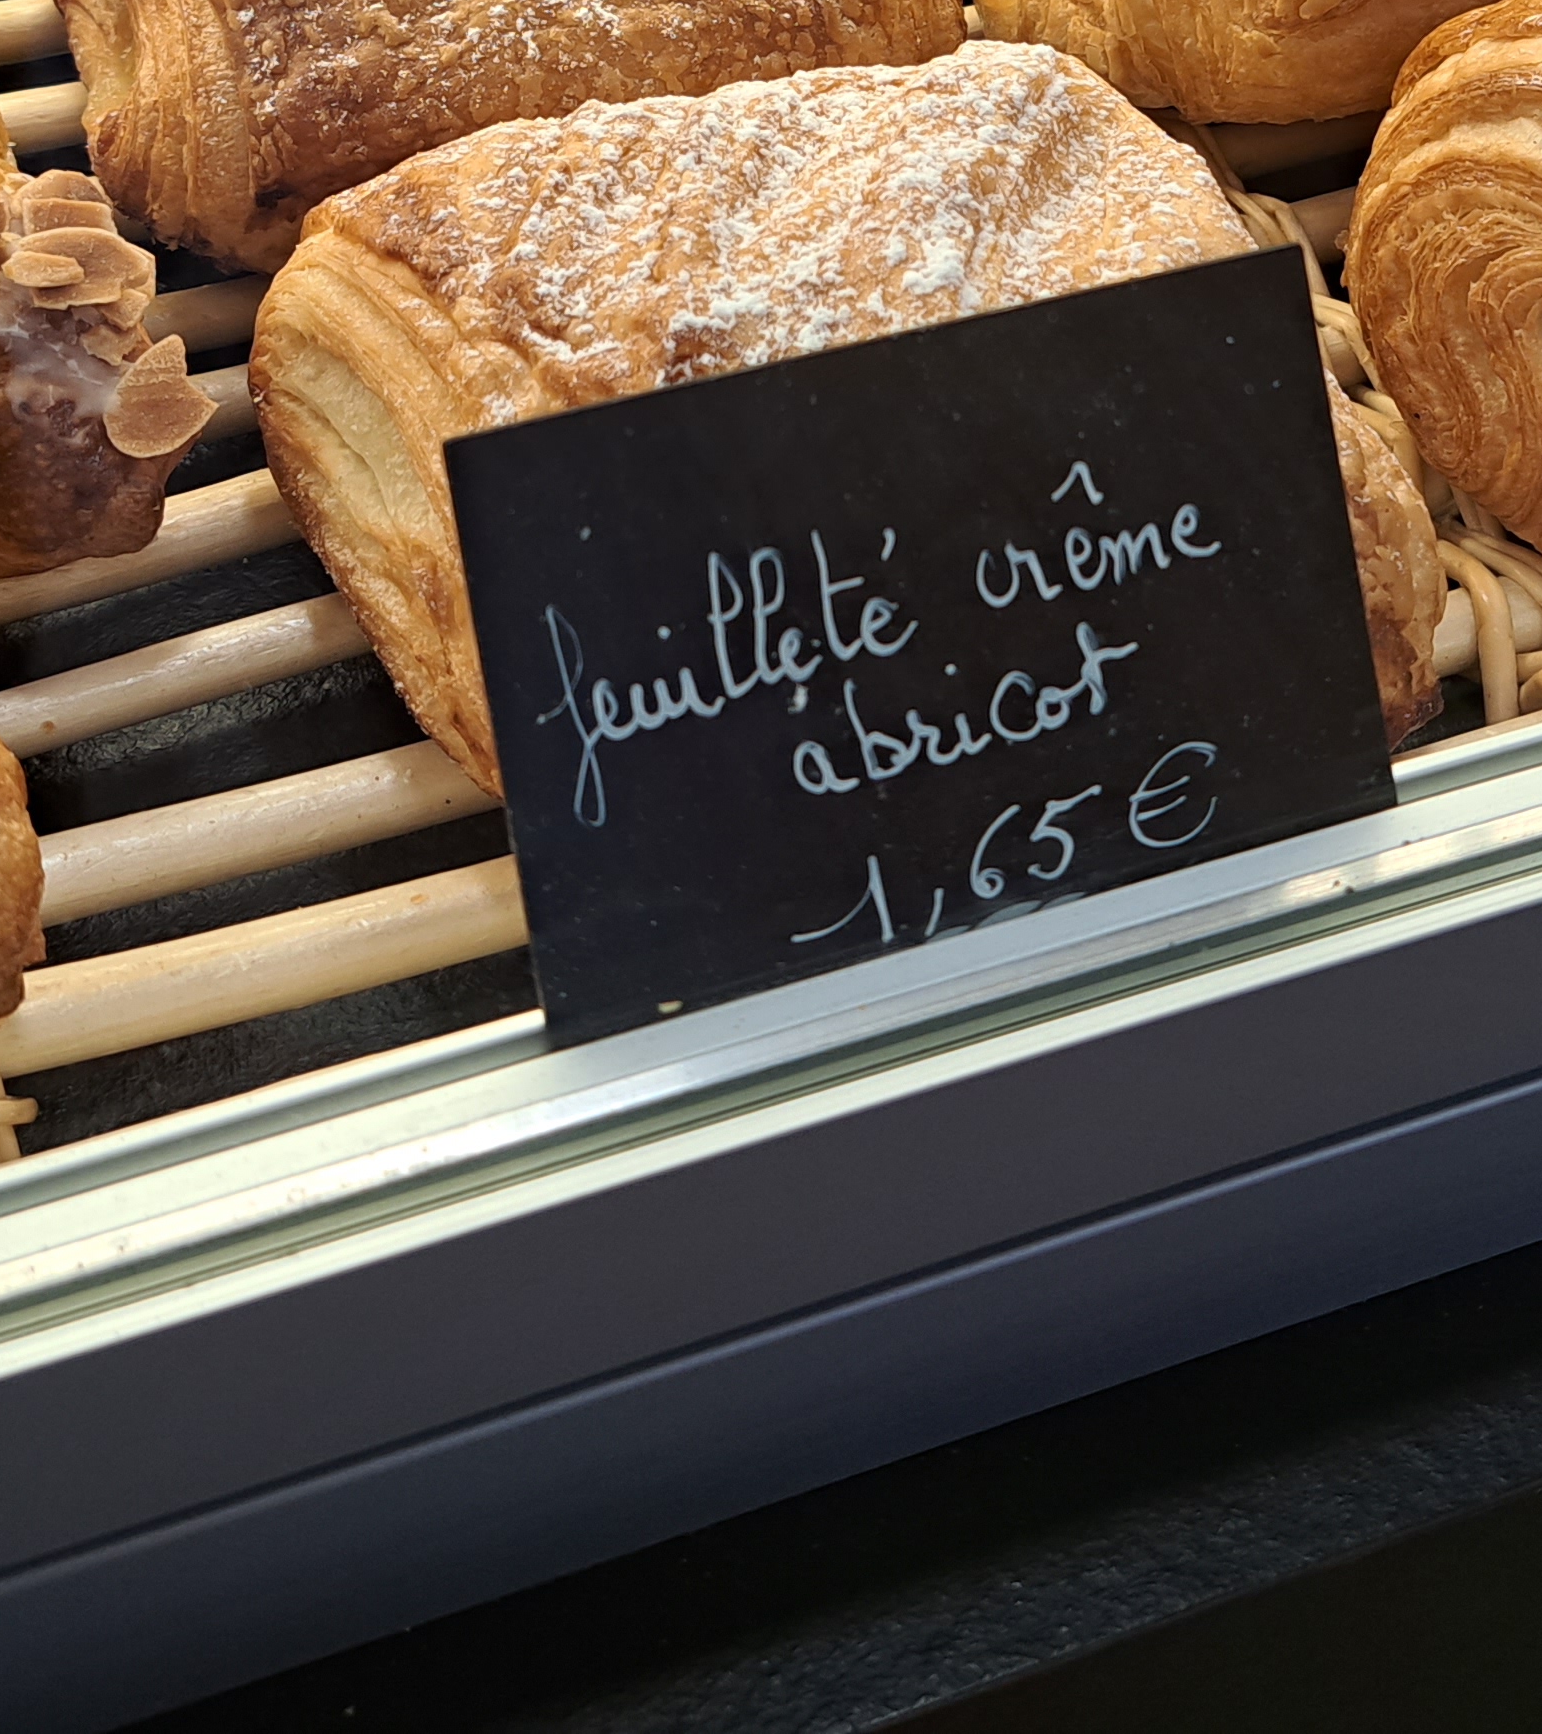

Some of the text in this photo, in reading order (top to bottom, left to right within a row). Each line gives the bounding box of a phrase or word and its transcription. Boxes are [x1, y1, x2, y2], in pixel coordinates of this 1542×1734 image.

[536, 528, 919, 828] feuilleté
[792, 621, 1139, 796] abricot
[790, 740, 1218, 944] 1,65€
